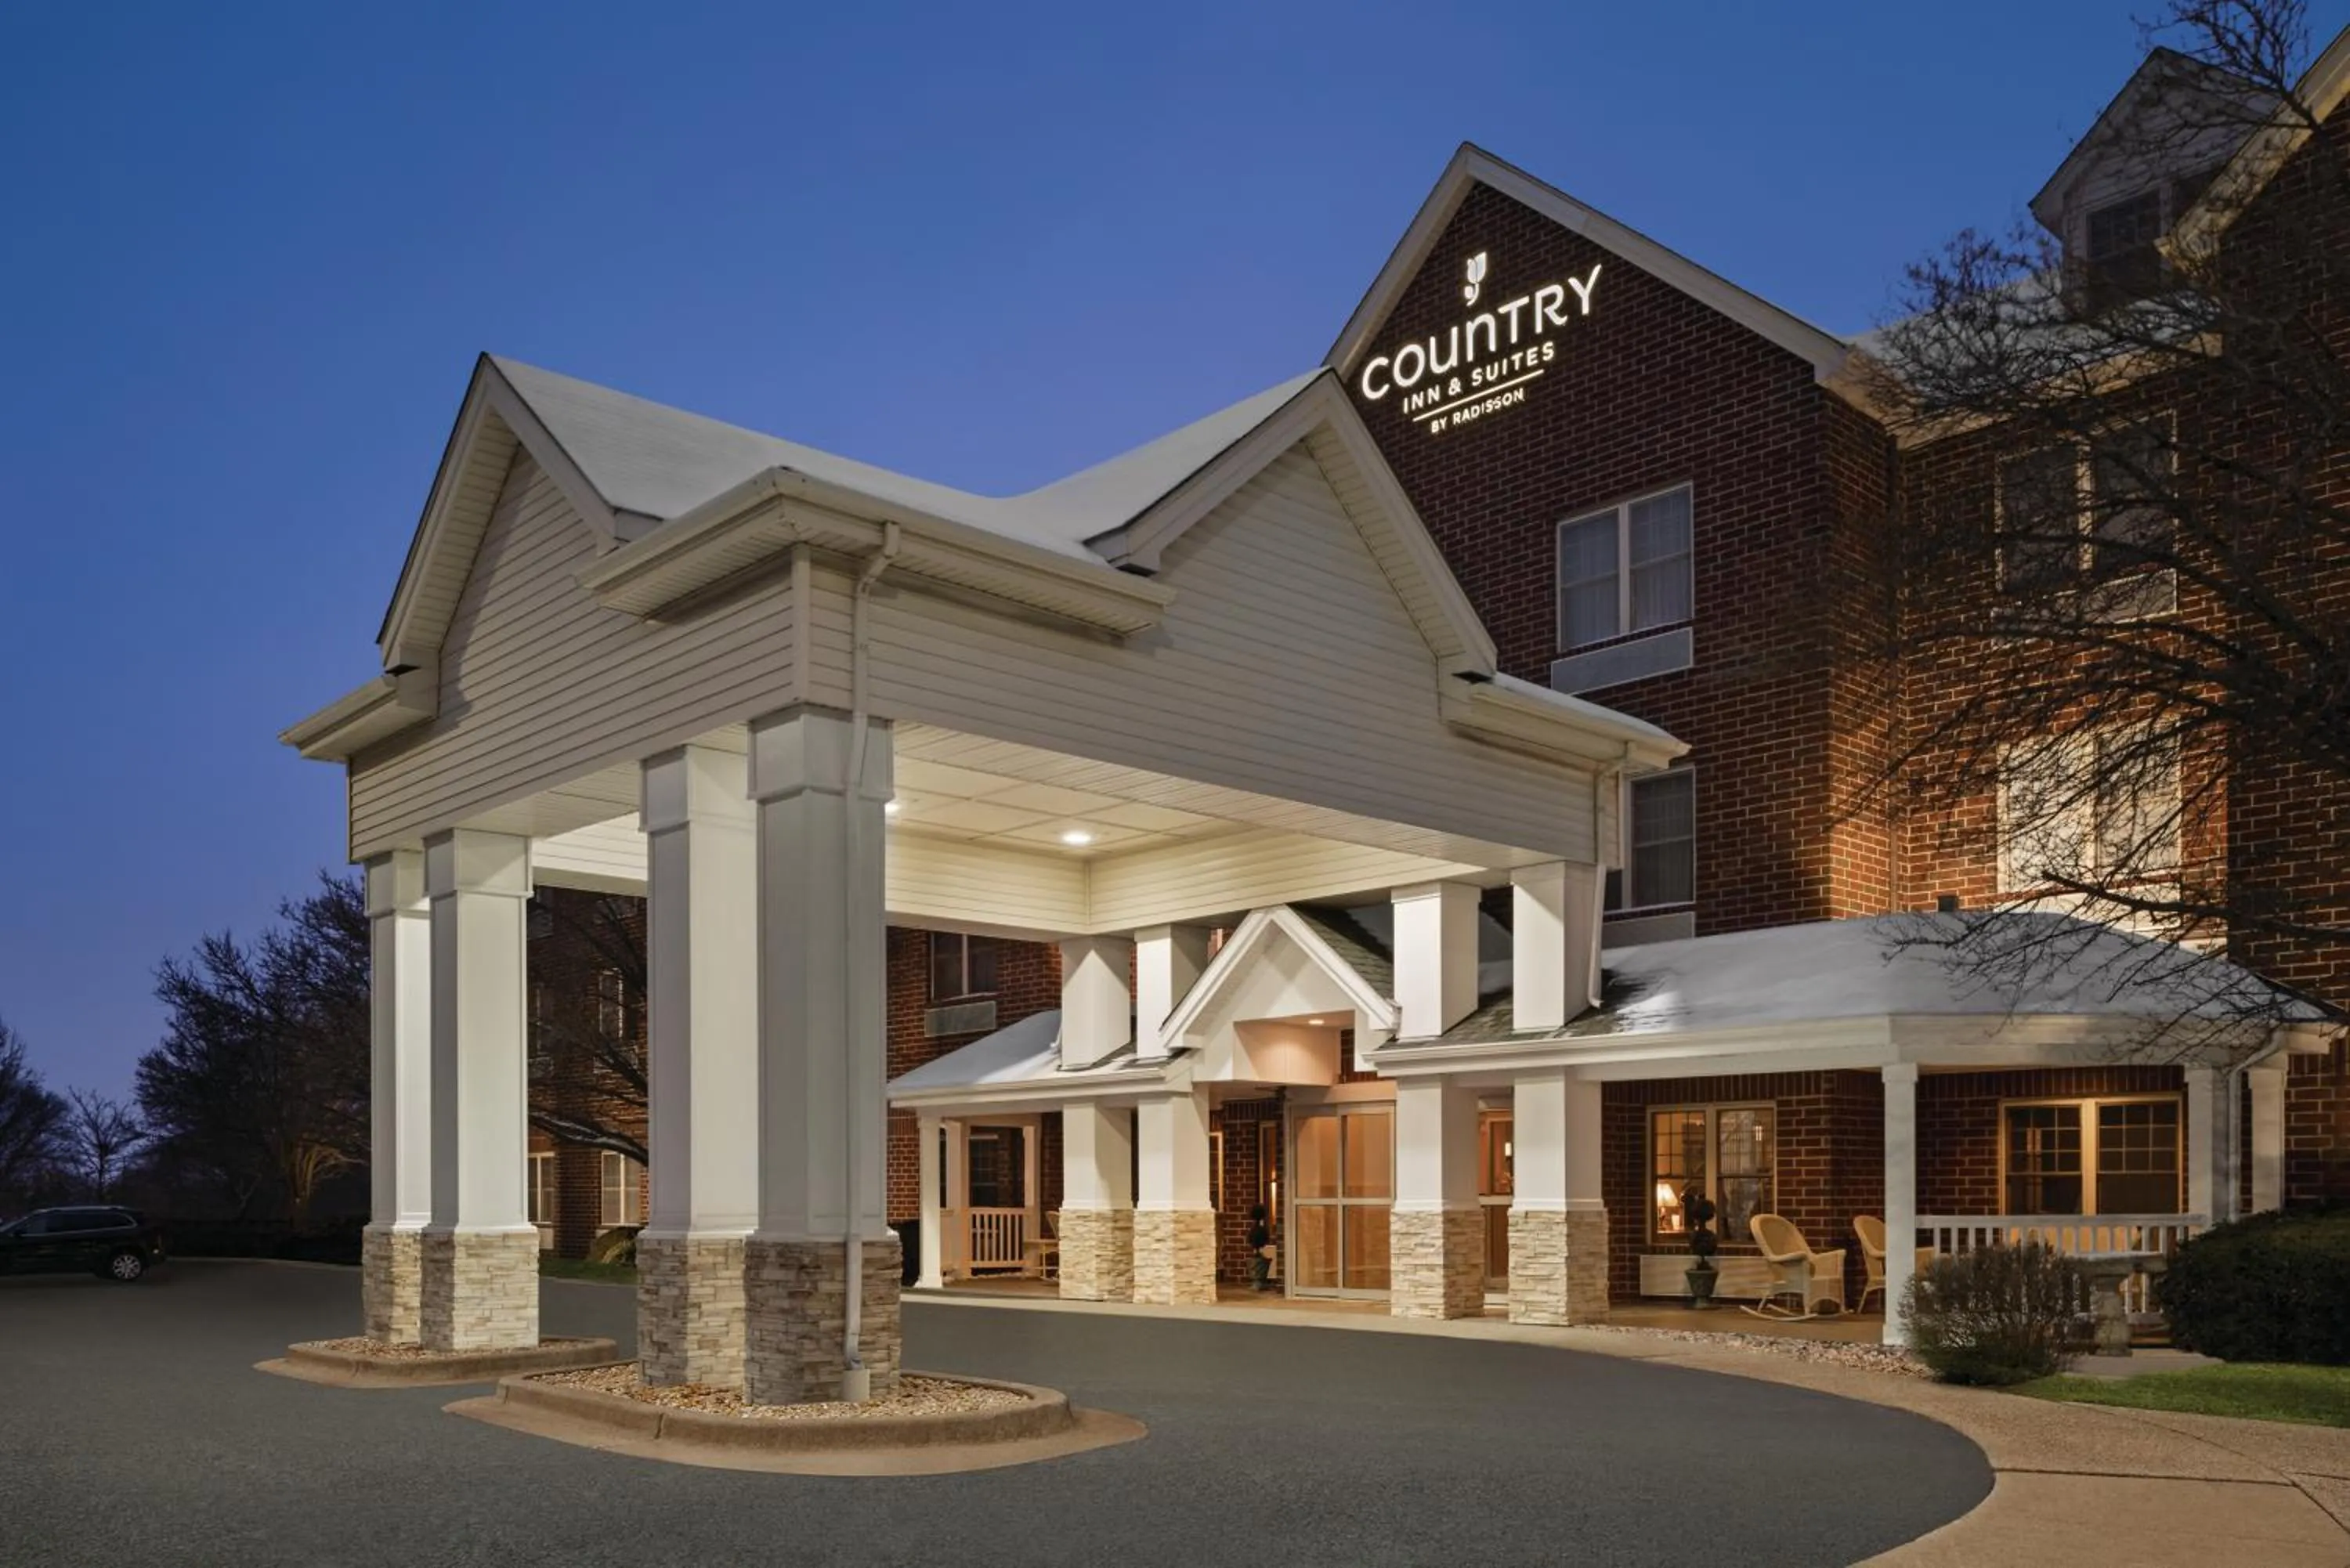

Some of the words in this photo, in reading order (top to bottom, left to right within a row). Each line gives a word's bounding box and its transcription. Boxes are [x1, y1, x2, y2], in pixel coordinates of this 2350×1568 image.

[1402, 385, 1441, 414] INN
[1448, 377, 1462, 396] &
[1471, 341, 1555, 387] SUITES
[1431, 416, 1448, 433] BY
[1452, 388, 1524, 425] RADISSON
